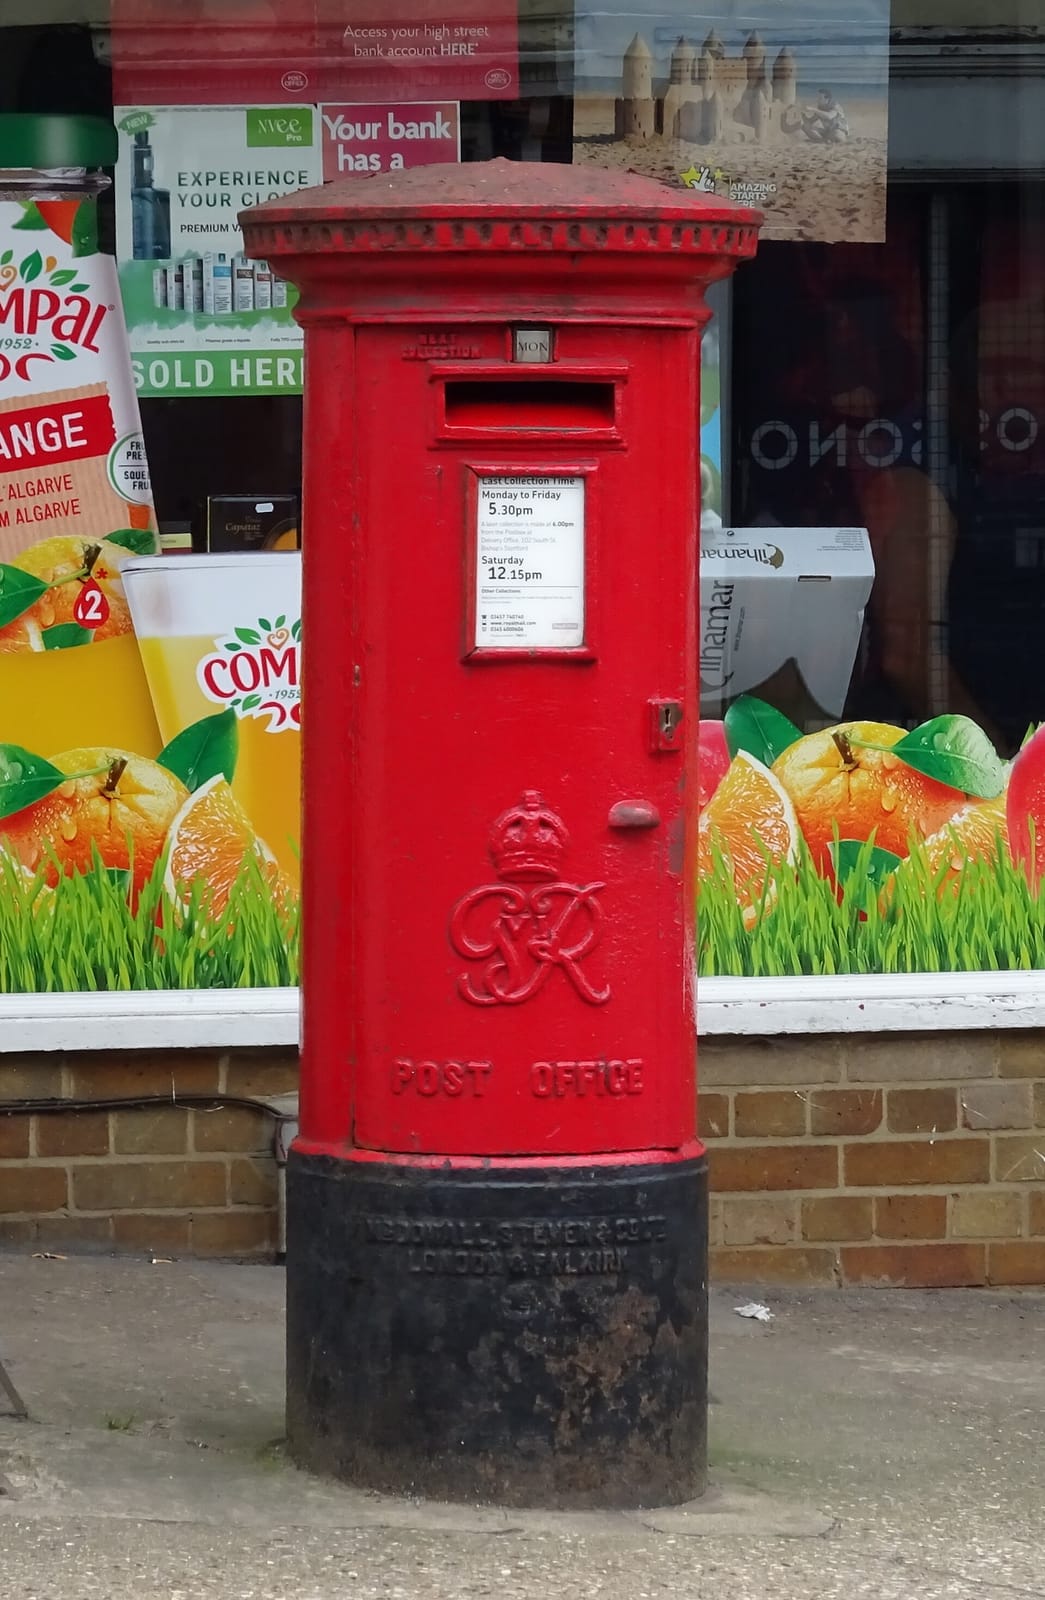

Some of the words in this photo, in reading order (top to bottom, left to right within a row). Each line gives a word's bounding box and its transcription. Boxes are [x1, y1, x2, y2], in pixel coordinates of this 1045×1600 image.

[344, 25, 387, 38] Access
[391, 28, 419, 41] your
[424, 25, 450, 40] high
[454, 26, 489, 37] street
[354, 43, 384, 56] bank
[387, 44, 437, 56] account
[126, 114, 147, 129] NEW
[322, 115, 382, 140] Your
[388, 112, 452, 139] bank
[286, 134, 302, 142] Pro
[338, 145, 381, 171] has
[390, 155, 404, 169] a
[177, 170, 309, 187] EXPERIENCE
[730, 183, 777, 192] AMAZING
[177, 193, 232, 208] YOUR
[241, 192, 287, 207] CLO
[730, 192, 768, 200] STARTS
[180, 224, 229, 233] PREMIUM
[517, 341, 548, 352] MON
[131, 359, 214, 389] SOLD
[230, 358, 304, 387] HER
[132, 481, 151, 490] FRU
[482, 477, 503, 485] Last
[504, 477, 549, 485] Collection
[552, 477, 575, 485] Time
[482, 491, 518, 500] Monday
[520, 491, 530, 499] to
[532, 491, 561, 500] Friday
[16, 498, 81, 525] ALGARVE
[488, 502, 533, 517] 5.30pm
[481, 555, 524, 565] Saturday
[488, 566, 542, 581] 12.15pm
[85, 590, 102, 620] 2
[391, 1058, 493, 1097] POST
[530, 1057, 644, 1098] OFFICE
